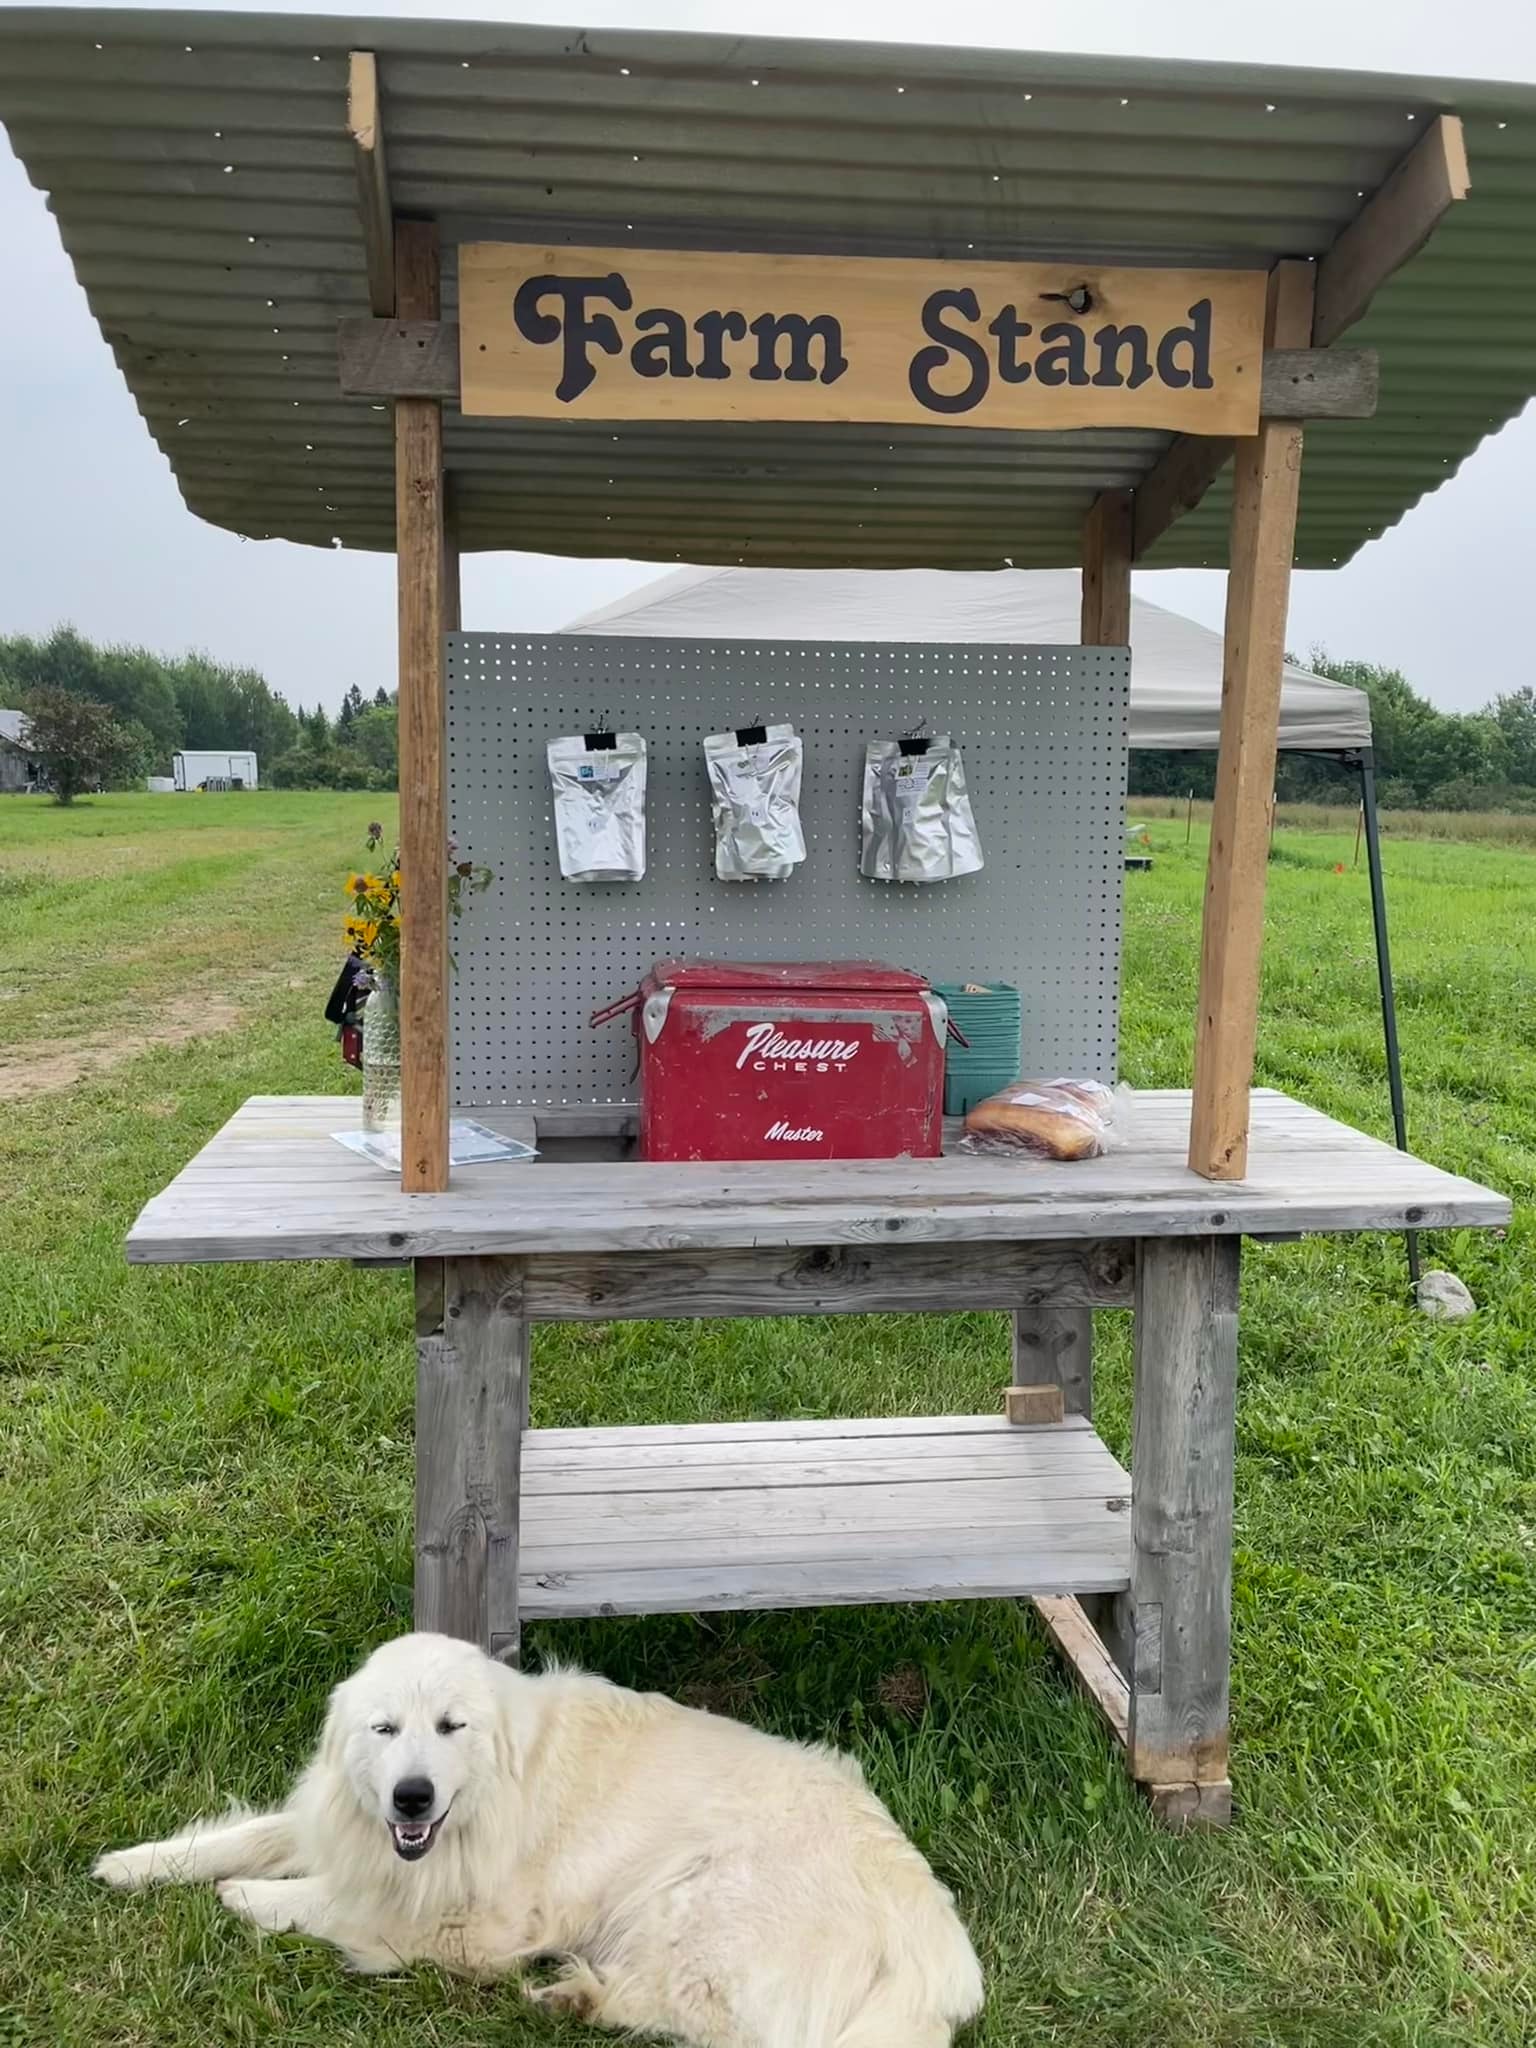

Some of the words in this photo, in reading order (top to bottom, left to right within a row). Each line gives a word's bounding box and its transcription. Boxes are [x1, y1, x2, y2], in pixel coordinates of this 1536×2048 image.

[513, 273, 848, 403] Farm
[909, 288, 1215, 413] Stand
[736, 1023, 860, 1070] Pleasure
[753, 1062, 847, 1073] CHEST
[764, 1121, 825, 1142] Master
